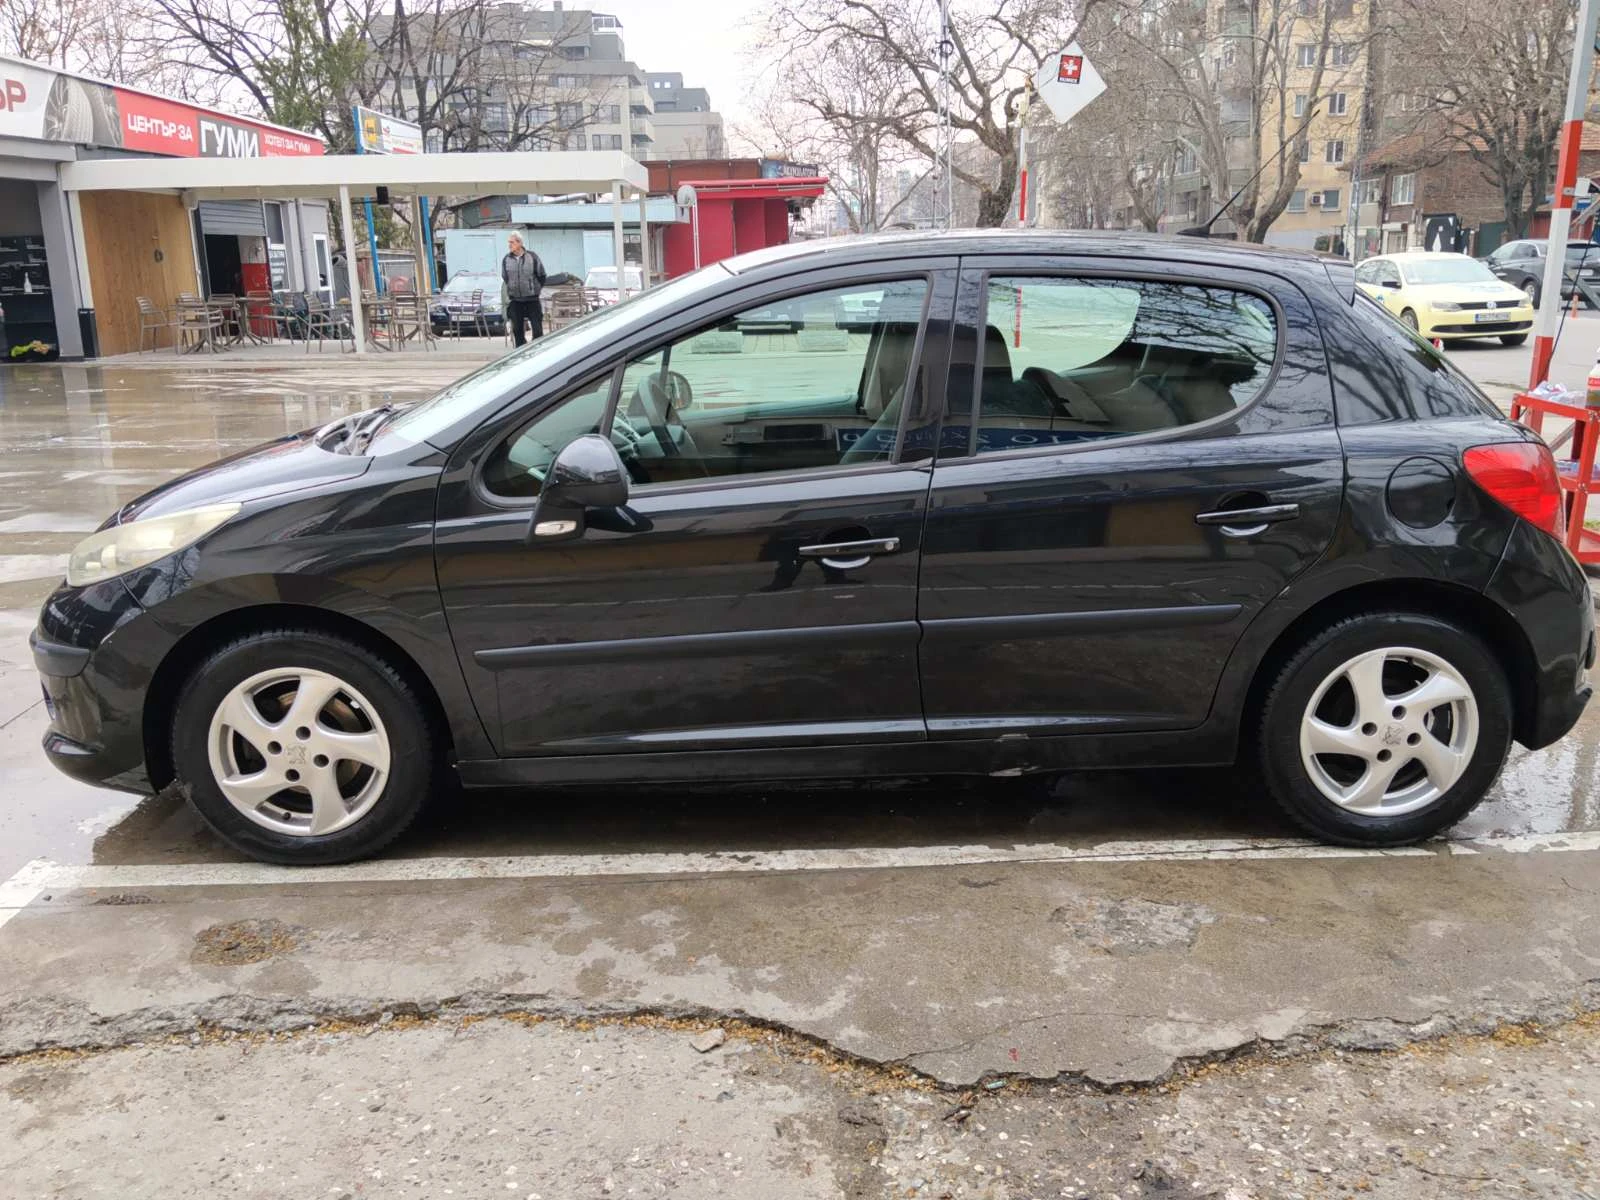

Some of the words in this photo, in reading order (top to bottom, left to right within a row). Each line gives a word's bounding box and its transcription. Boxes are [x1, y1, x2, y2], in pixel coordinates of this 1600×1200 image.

[0, 79, 26, 112] Р
[127, 113, 177, 138] ЦЕНТЪР
[178, 124, 193, 141] ЗА
[200, 120, 259, 158] ГУМИ
